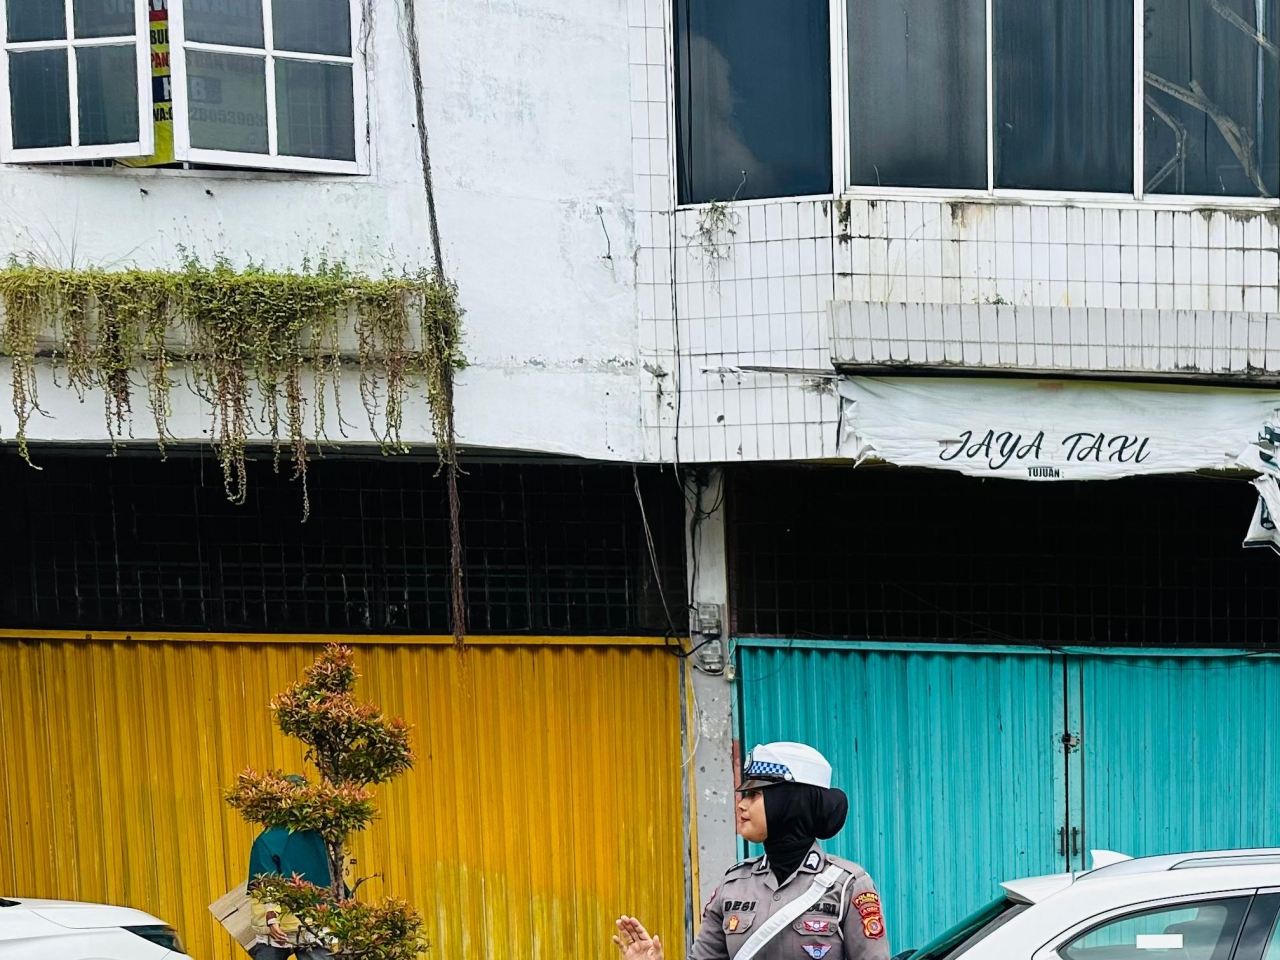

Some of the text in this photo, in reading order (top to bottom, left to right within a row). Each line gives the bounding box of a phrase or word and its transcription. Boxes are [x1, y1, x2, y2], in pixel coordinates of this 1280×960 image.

[939, 429, 1150, 470] JAYA TAXI
[724, 900, 756, 912] DESI
